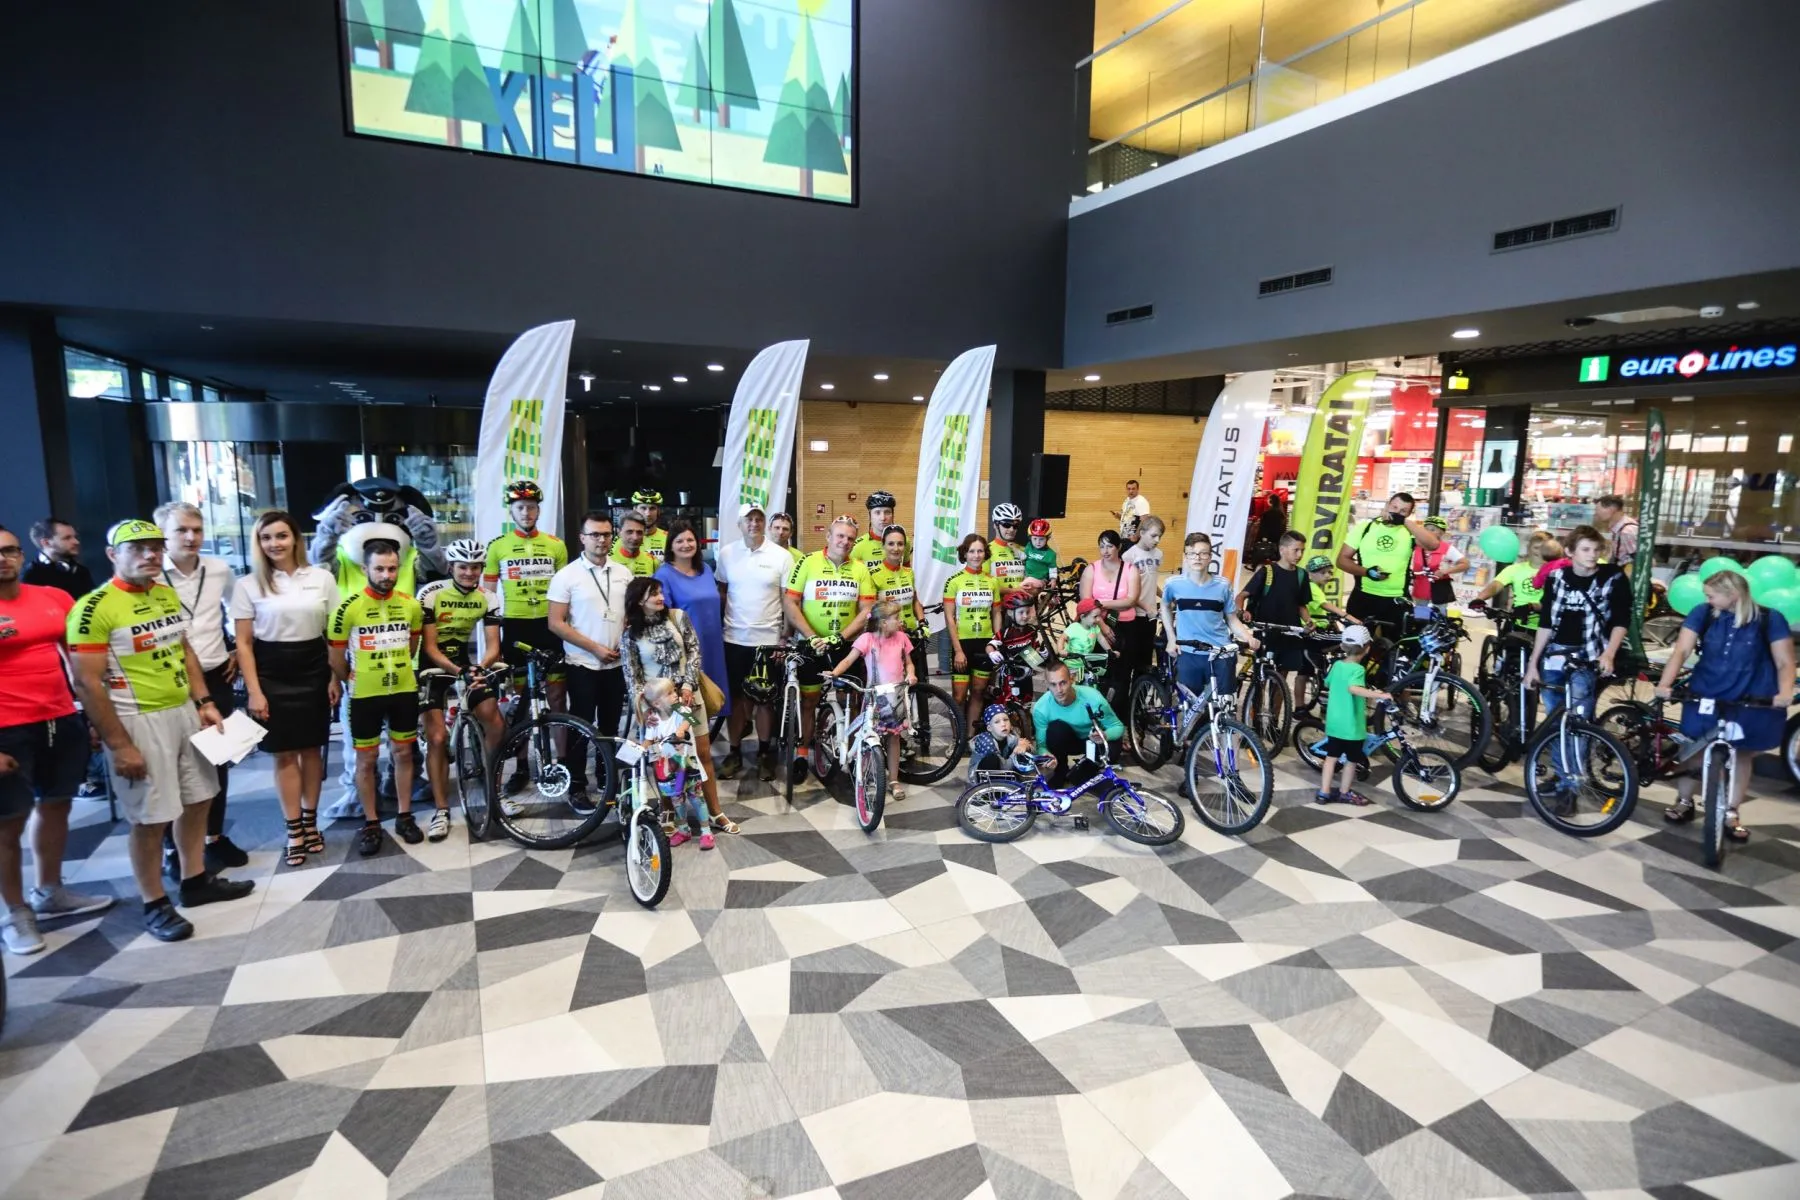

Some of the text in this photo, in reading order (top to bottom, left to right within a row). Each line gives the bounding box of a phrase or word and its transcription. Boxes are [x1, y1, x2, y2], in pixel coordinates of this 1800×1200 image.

[1207, 427, 1240, 576] DAISTATUS
[1311, 399, 1355, 550] DVIRATAI
[440, 600, 482, 609] DVIRATAI
[815, 580, 858, 589] DVIRATAI
